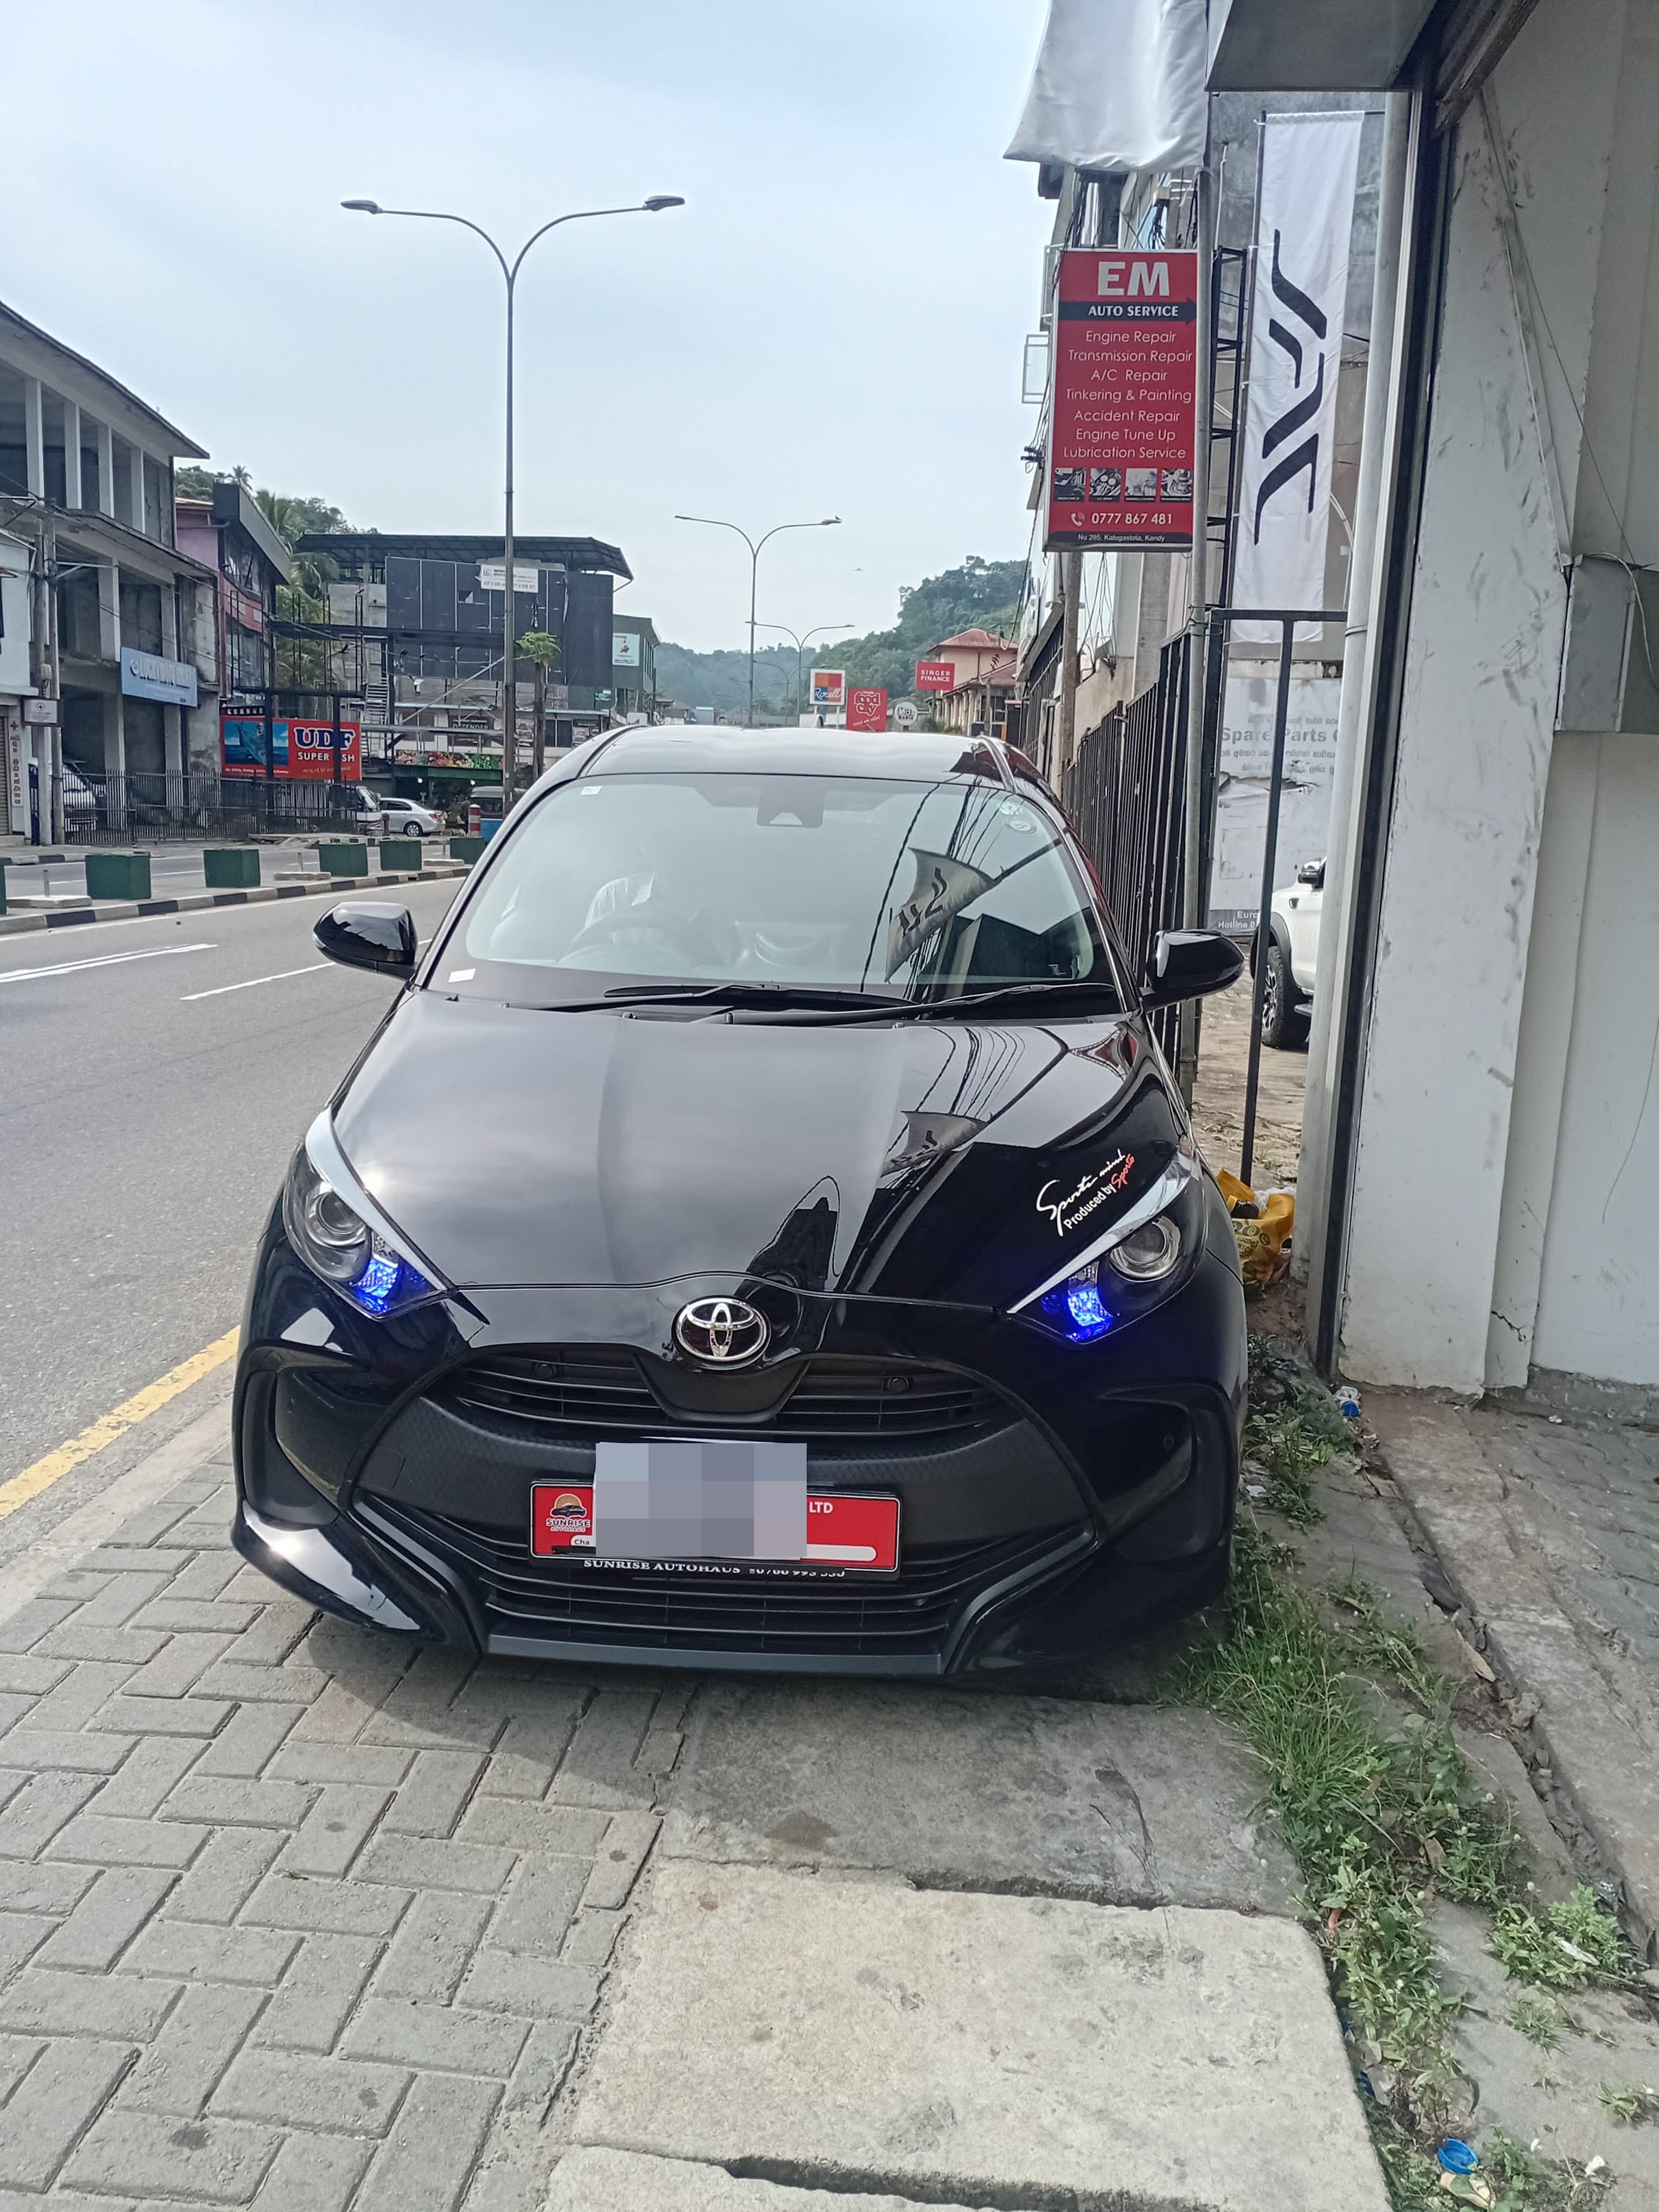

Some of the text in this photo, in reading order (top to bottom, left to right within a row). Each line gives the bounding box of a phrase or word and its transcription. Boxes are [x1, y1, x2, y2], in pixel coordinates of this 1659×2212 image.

[1097, 261, 1169, 296] EM
[1089, 306, 1178, 317] AUTO SERVICE
[1086, 331, 1175, 344] Engine Repair
[1069, 350, 1193, 363] Transmission Repair
[1091, 369, 1167, 383] A/C Repair
[1066, 389, 1192, 403] Tinkering & Painting
[1074, 410, 1180, 423] Accident Repair
[1076, 429, 1175, 442] Engine Tune Up
[1064, 447, 1186, 459] Lubrication Service
[1091, 513, 1172, 524] 0777 867 481
[293, 727, 355, 750] UDF
[1222, 728, 1271, 744] Spare
[298, 752, 330, 761] SUPER
[1063, 1187, 1107, 1229] Produced
[1101, 1182, 1117, 1193] by
[809, 1501, 833, 1513] LTD
[546, 1518, 590, 1527] SUNRISE
[584, 1560, 650, 1570] SUNRISE
[653, 1562, 741, 1573] AUTOHAUS
